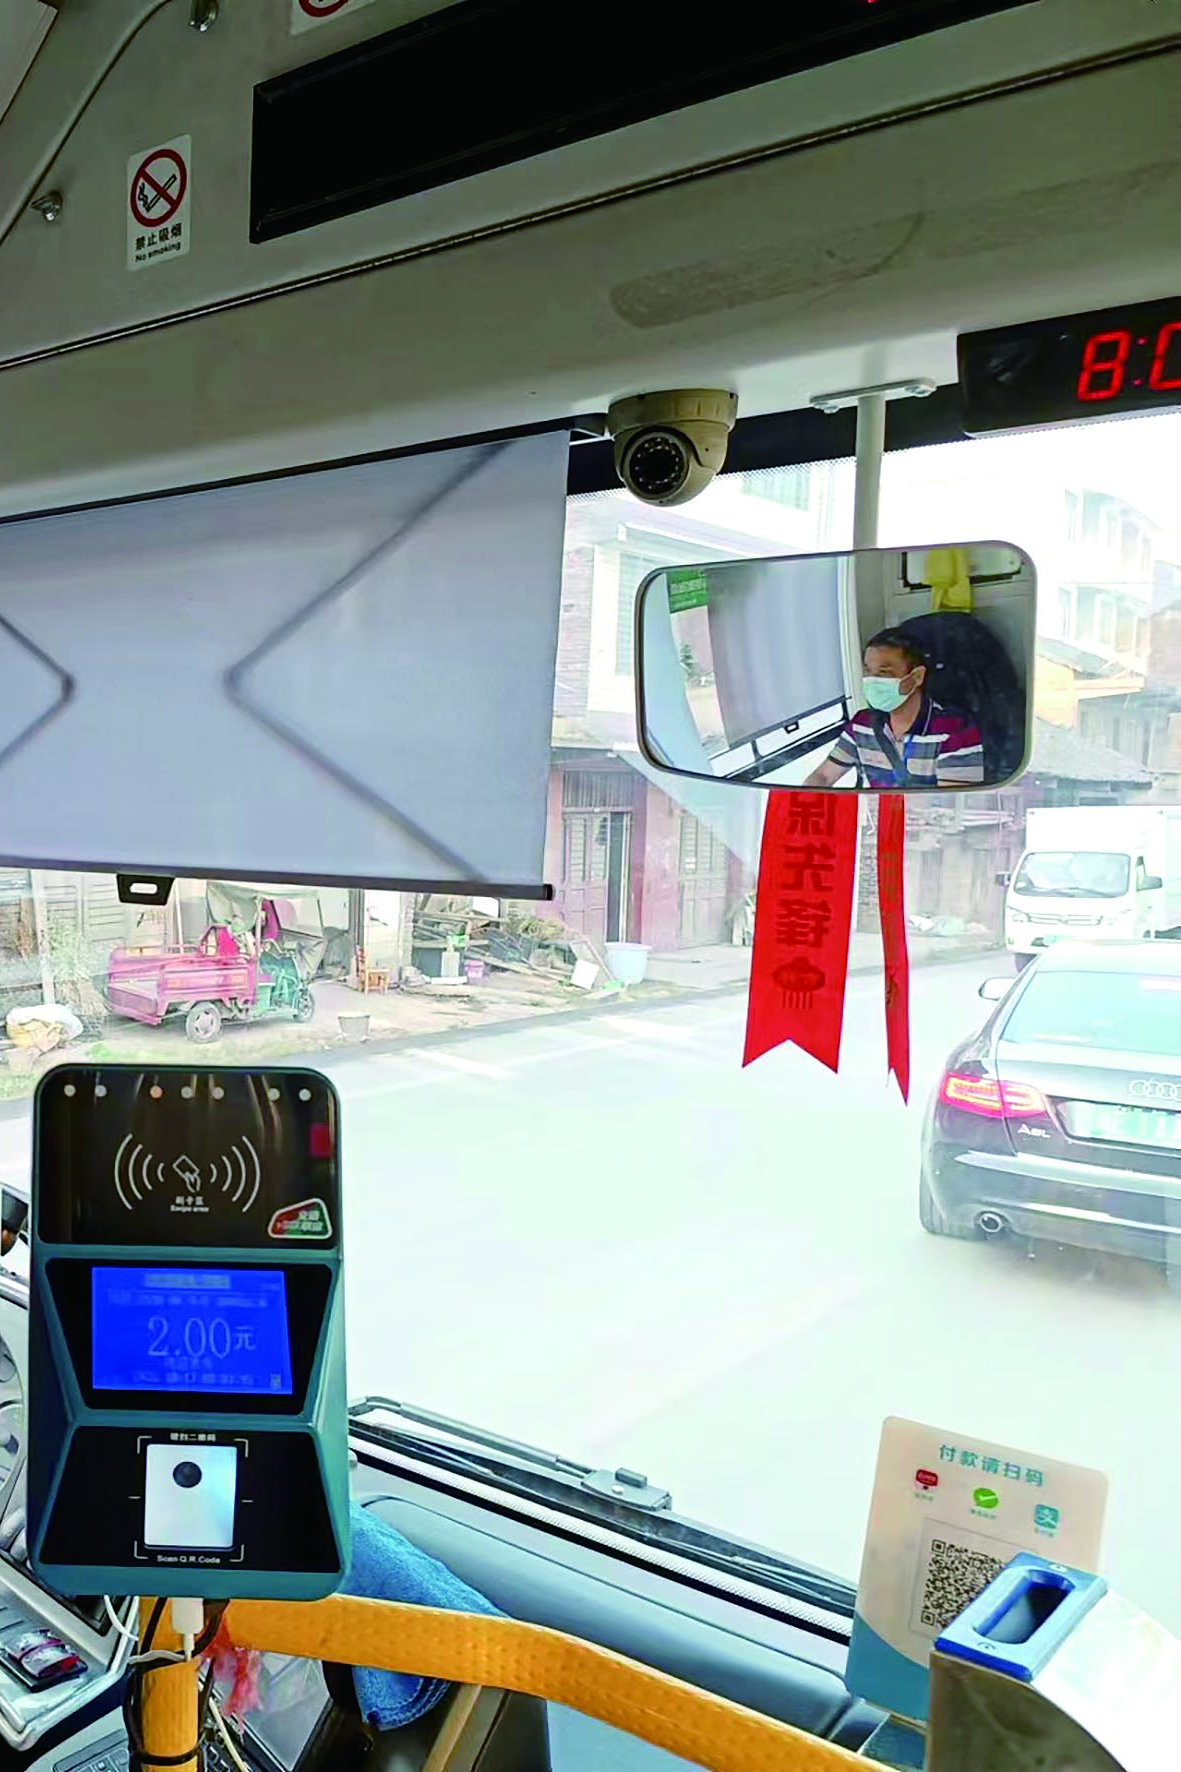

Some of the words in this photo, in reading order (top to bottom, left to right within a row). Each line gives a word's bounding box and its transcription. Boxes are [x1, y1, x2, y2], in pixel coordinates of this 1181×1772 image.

[135, 222, 182, 251] 禁止吸烟
[939, 1444, 1044, 1487] 付款请扫码
[157, 1554, 178, 1563] Scan
